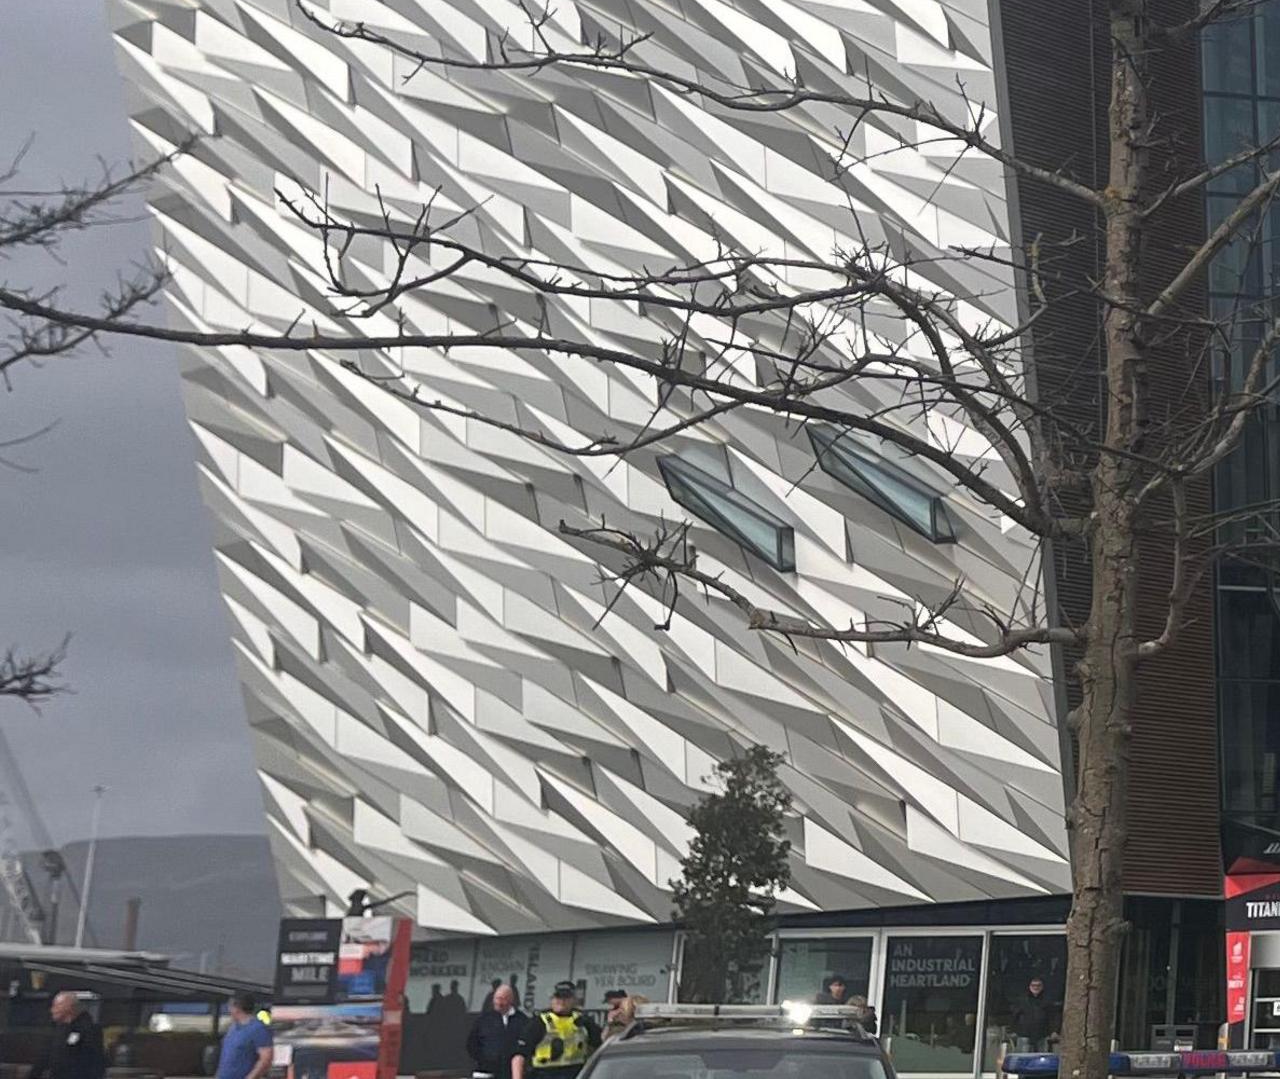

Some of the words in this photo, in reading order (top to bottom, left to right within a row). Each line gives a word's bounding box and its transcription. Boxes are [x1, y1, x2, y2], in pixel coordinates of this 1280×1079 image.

[894, 943, 913, 957] AN
[891, 958, 976, 972] INDUSTRIAL
[291, 966, 329, 982] MILE
[889, 973, 971, 987] HEARTLAND
